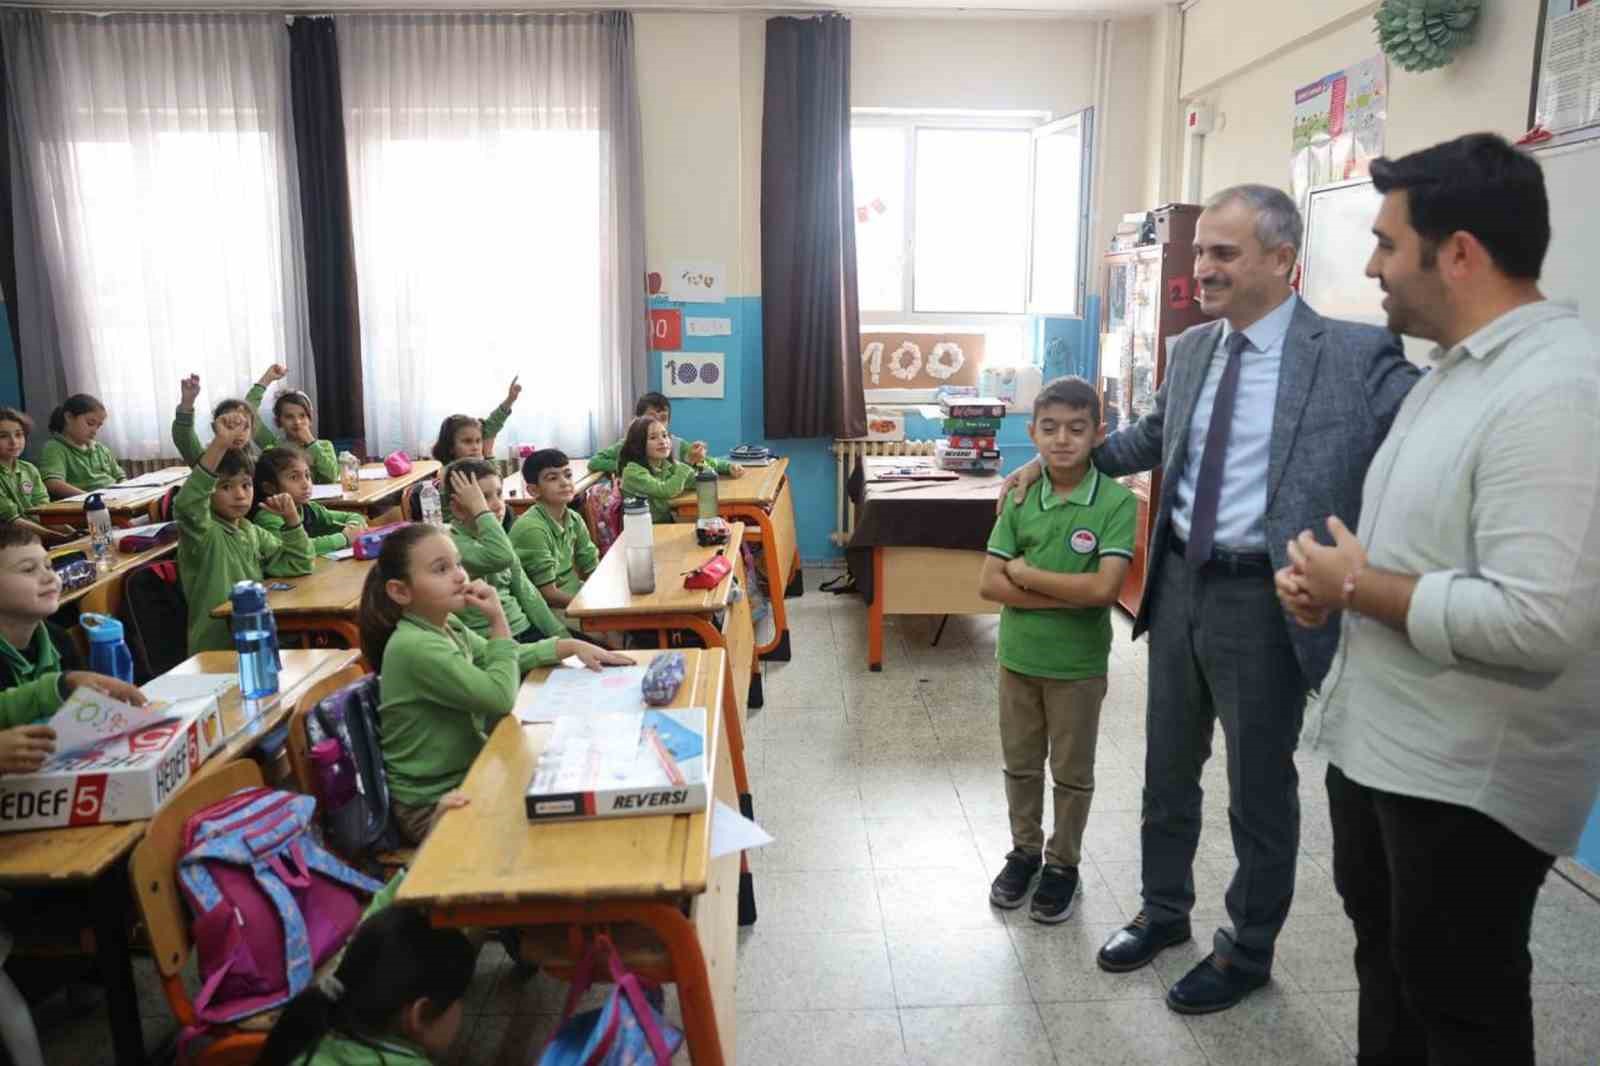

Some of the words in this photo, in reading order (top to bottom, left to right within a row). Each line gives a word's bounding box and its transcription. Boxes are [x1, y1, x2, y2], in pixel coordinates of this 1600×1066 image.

[664, 359, 720, 386] 100
[863, 340, 966, 386] 100
[156, 742, 186, 804] HEDEF
[187, 733, 199, 763] 5
[0, 787, 69, 820] EDEF
[75, 784, 99, 817] 5
[612, 789, 688, 809] REVERSI
